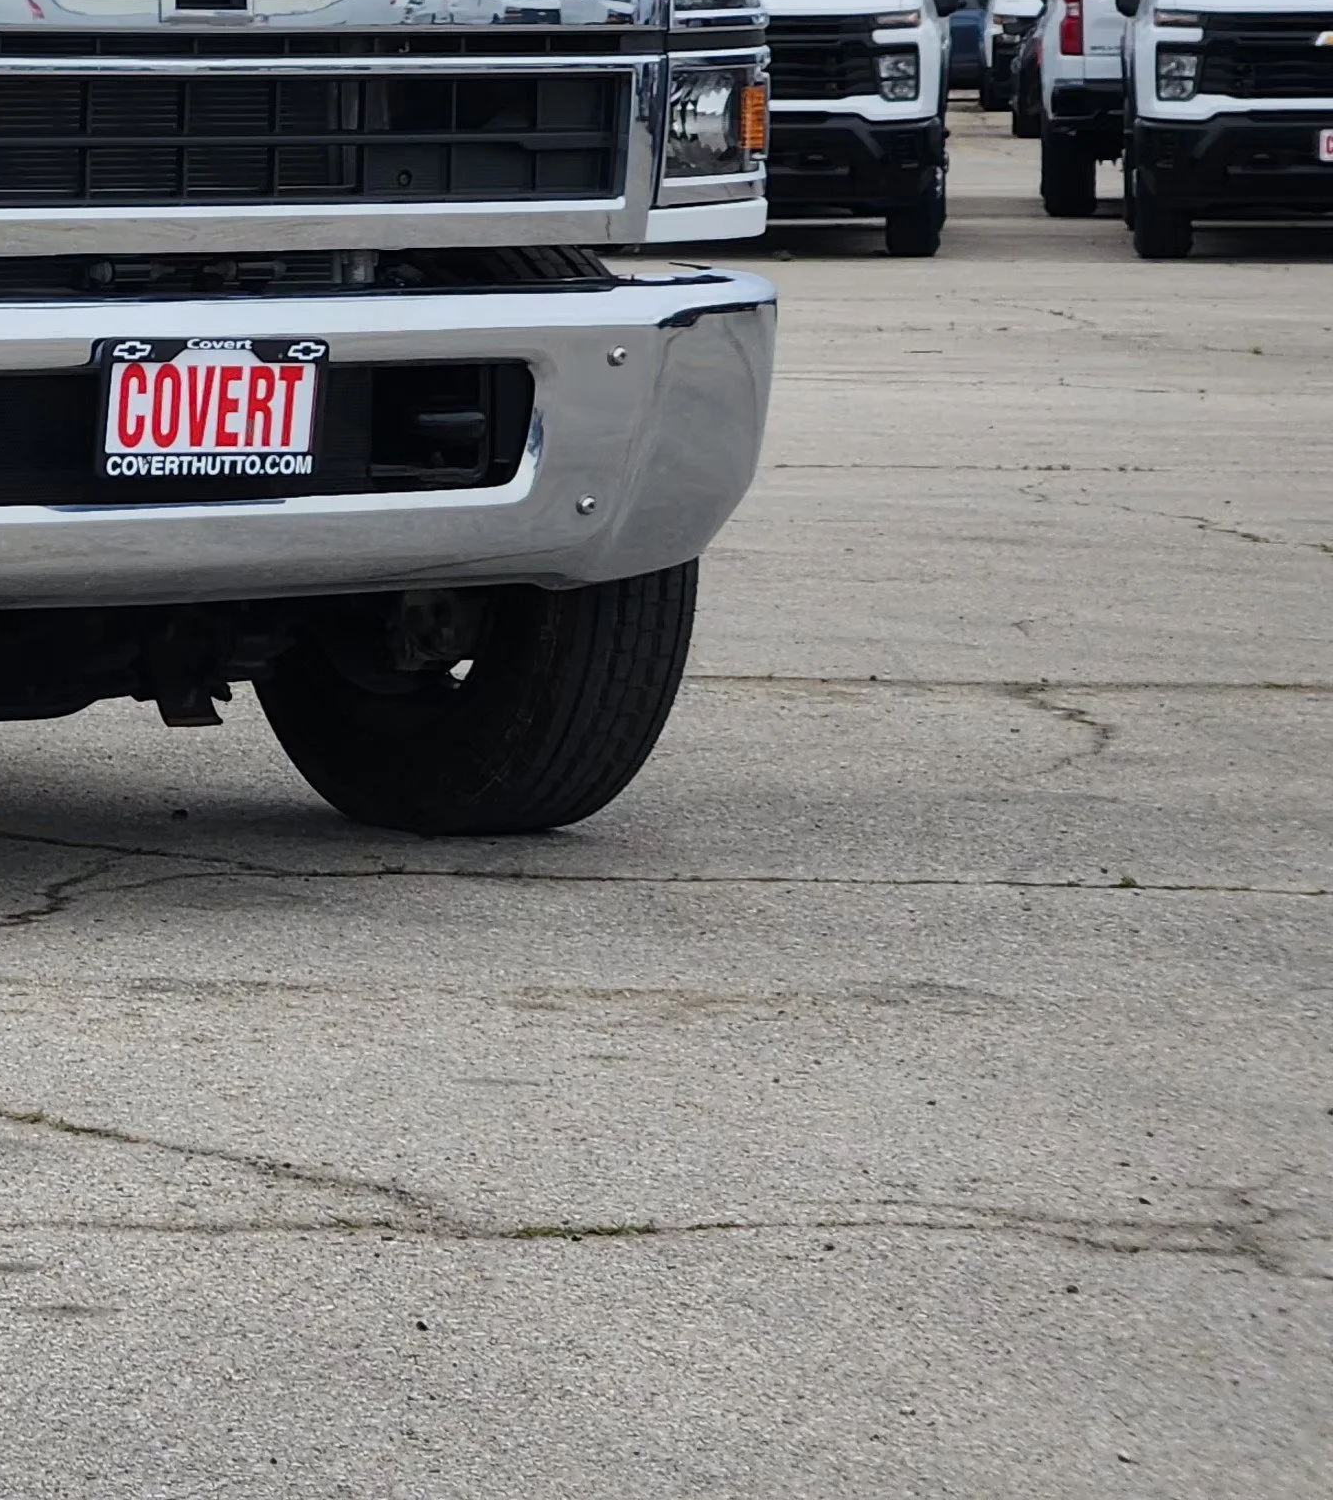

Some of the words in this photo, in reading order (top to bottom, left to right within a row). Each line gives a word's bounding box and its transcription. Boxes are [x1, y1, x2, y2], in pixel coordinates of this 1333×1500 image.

[186, 338, 254, 350] Covert
[117, 362, 305, 449] COVERT
[105, 454, 314, 477] COVERTHUTTO.COM
